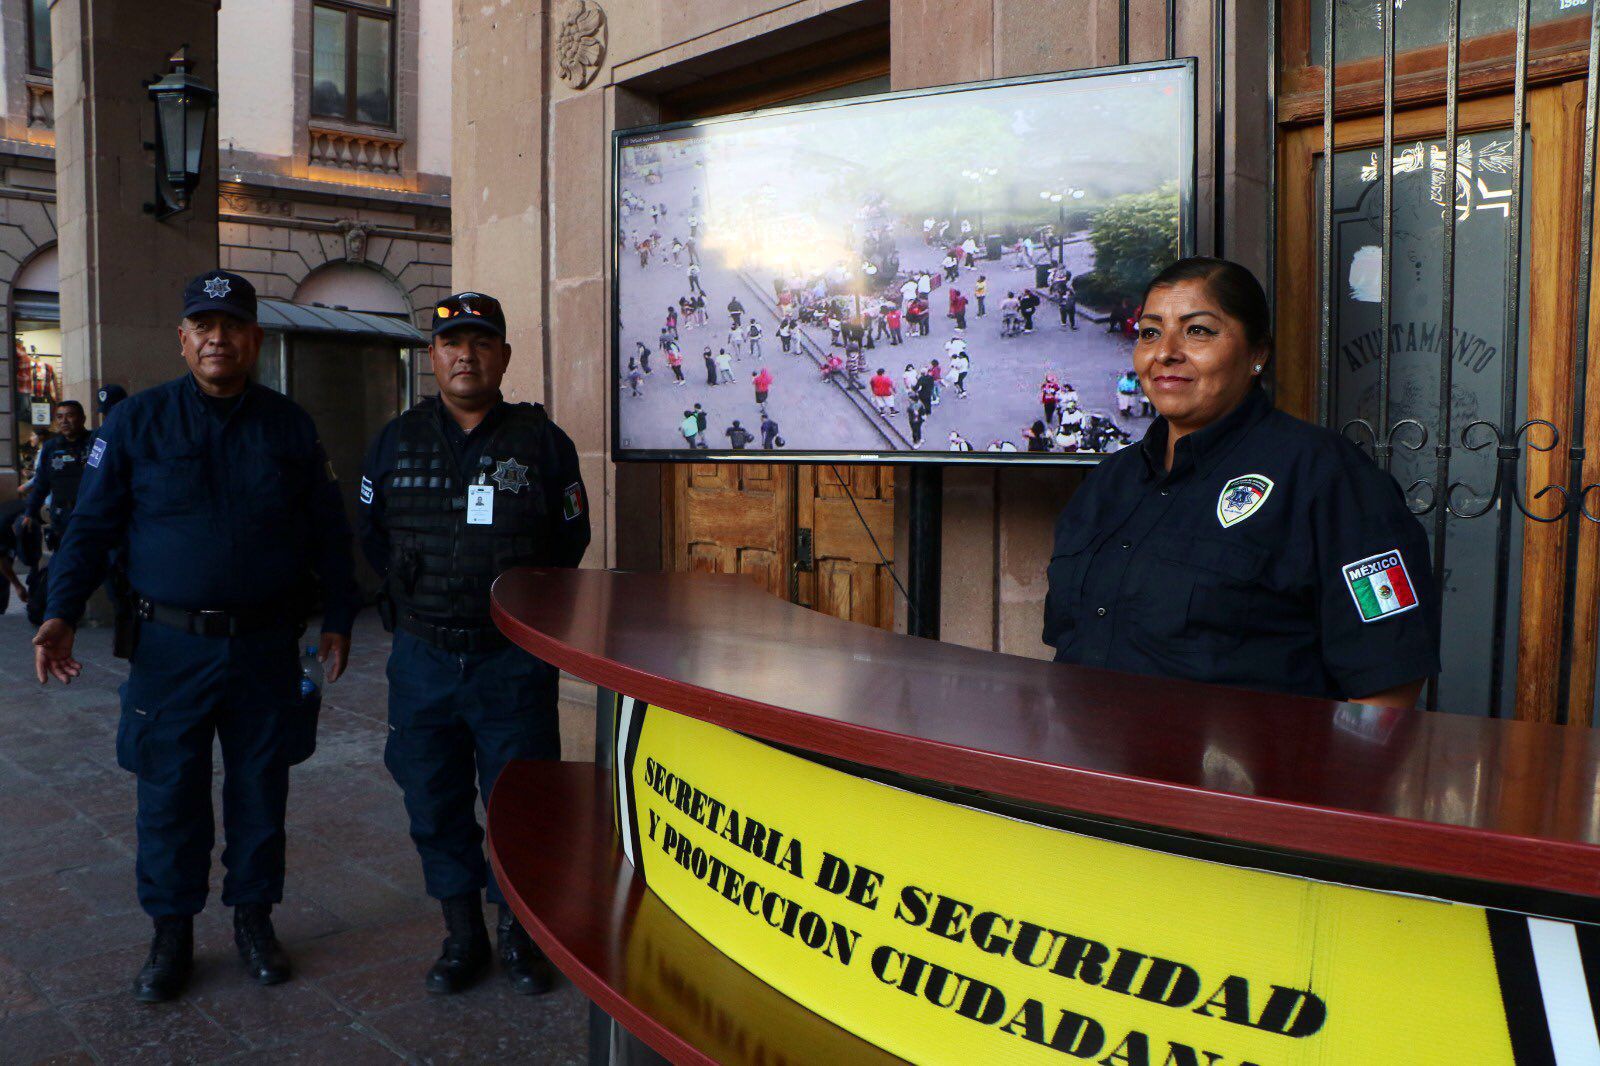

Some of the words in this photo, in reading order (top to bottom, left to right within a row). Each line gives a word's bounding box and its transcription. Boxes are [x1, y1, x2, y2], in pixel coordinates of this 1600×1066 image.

[1349, 556, 1398, 581] MÉXICO
[644, 756, 804, 879] SECRETARIA
[814, 851, 885, 911] DE
[893, 885, 1328, 1039] SEGURIDAD
[648, 808, 662, 845] Y
[662, 822, 862, 966] PROTECCION
[870, 945, 1260, 1066] CIUDADAN
